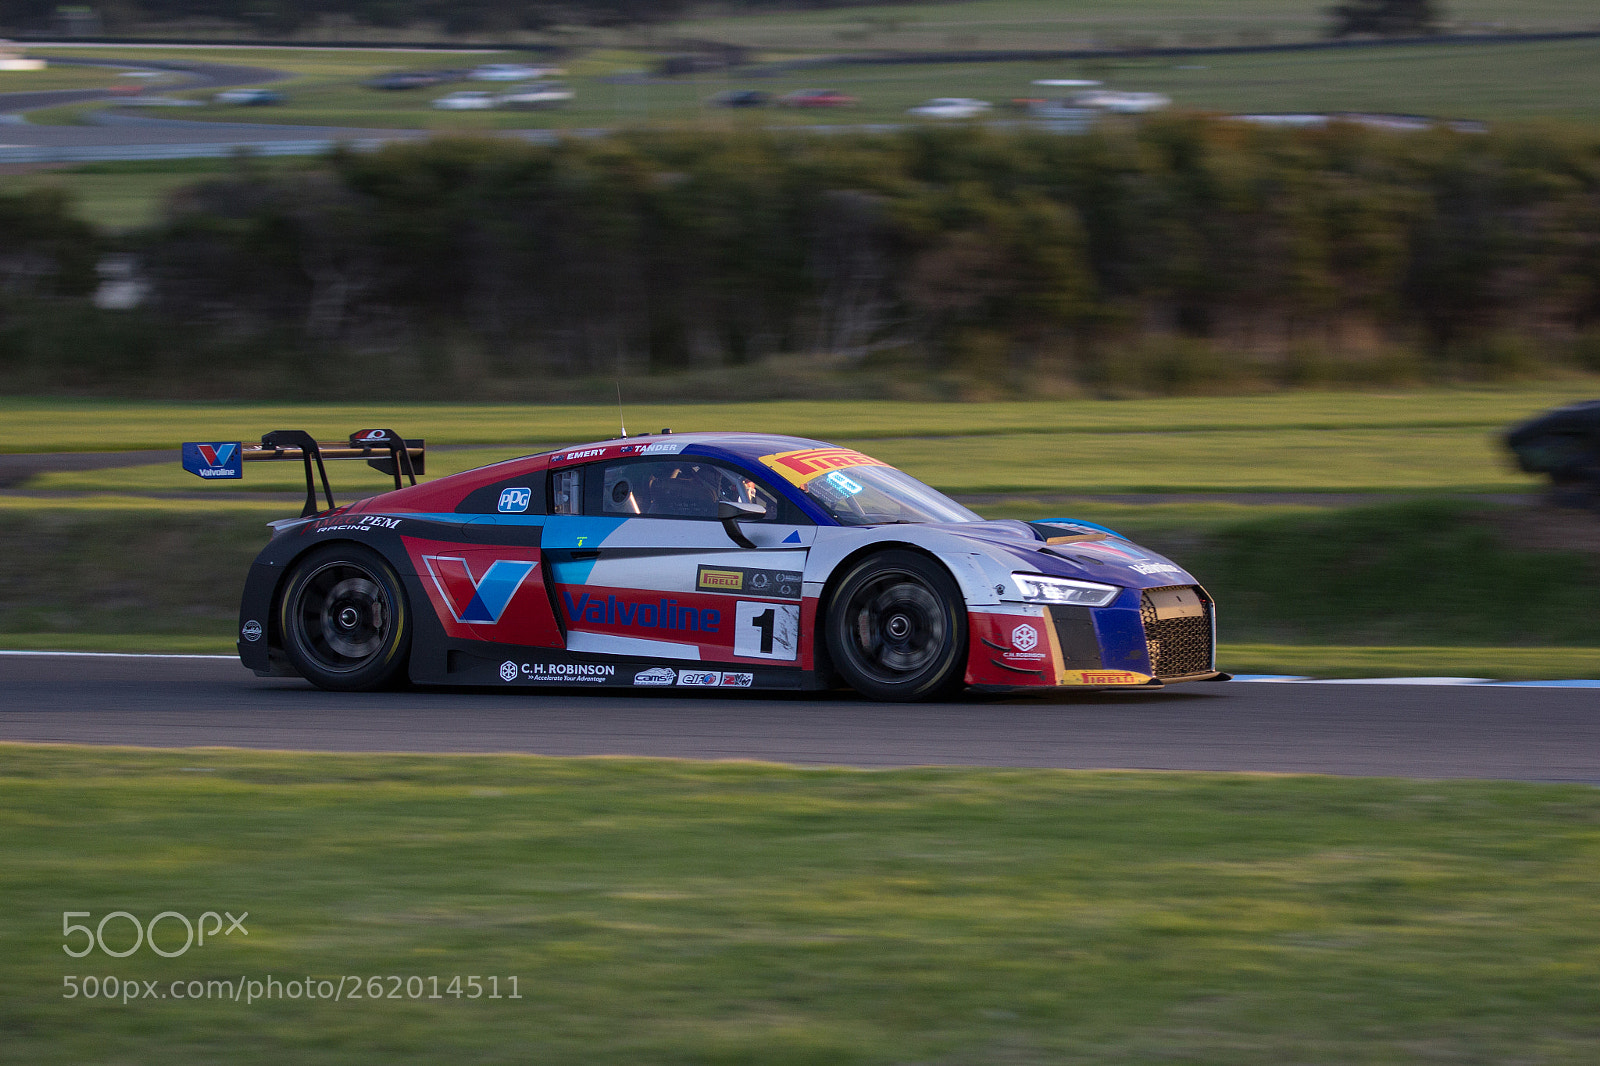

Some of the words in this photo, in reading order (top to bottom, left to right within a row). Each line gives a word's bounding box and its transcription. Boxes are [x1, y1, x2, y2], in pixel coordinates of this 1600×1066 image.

[566, 448, 606, 460] EMERY
[635, 444, 677, 453] TANDER
[199, 468, 235, 477] Valvoline
[360, 515, 402, 529] PEM
[317, 525, 371, 533] RACING
[703, 573, 739, 586] PIRELLI
[563, 591, 721, 633] Valvoline
[752, 609, 775, 654] 1
[521, 663, 547, 674] C.H.
[548, 664, 615, 675] ROBINSON
[576, 675, 606, 683] Advantage
[683, 673, 706, 684] elf
[1082, 672, 1135, 683] PIRELLI
